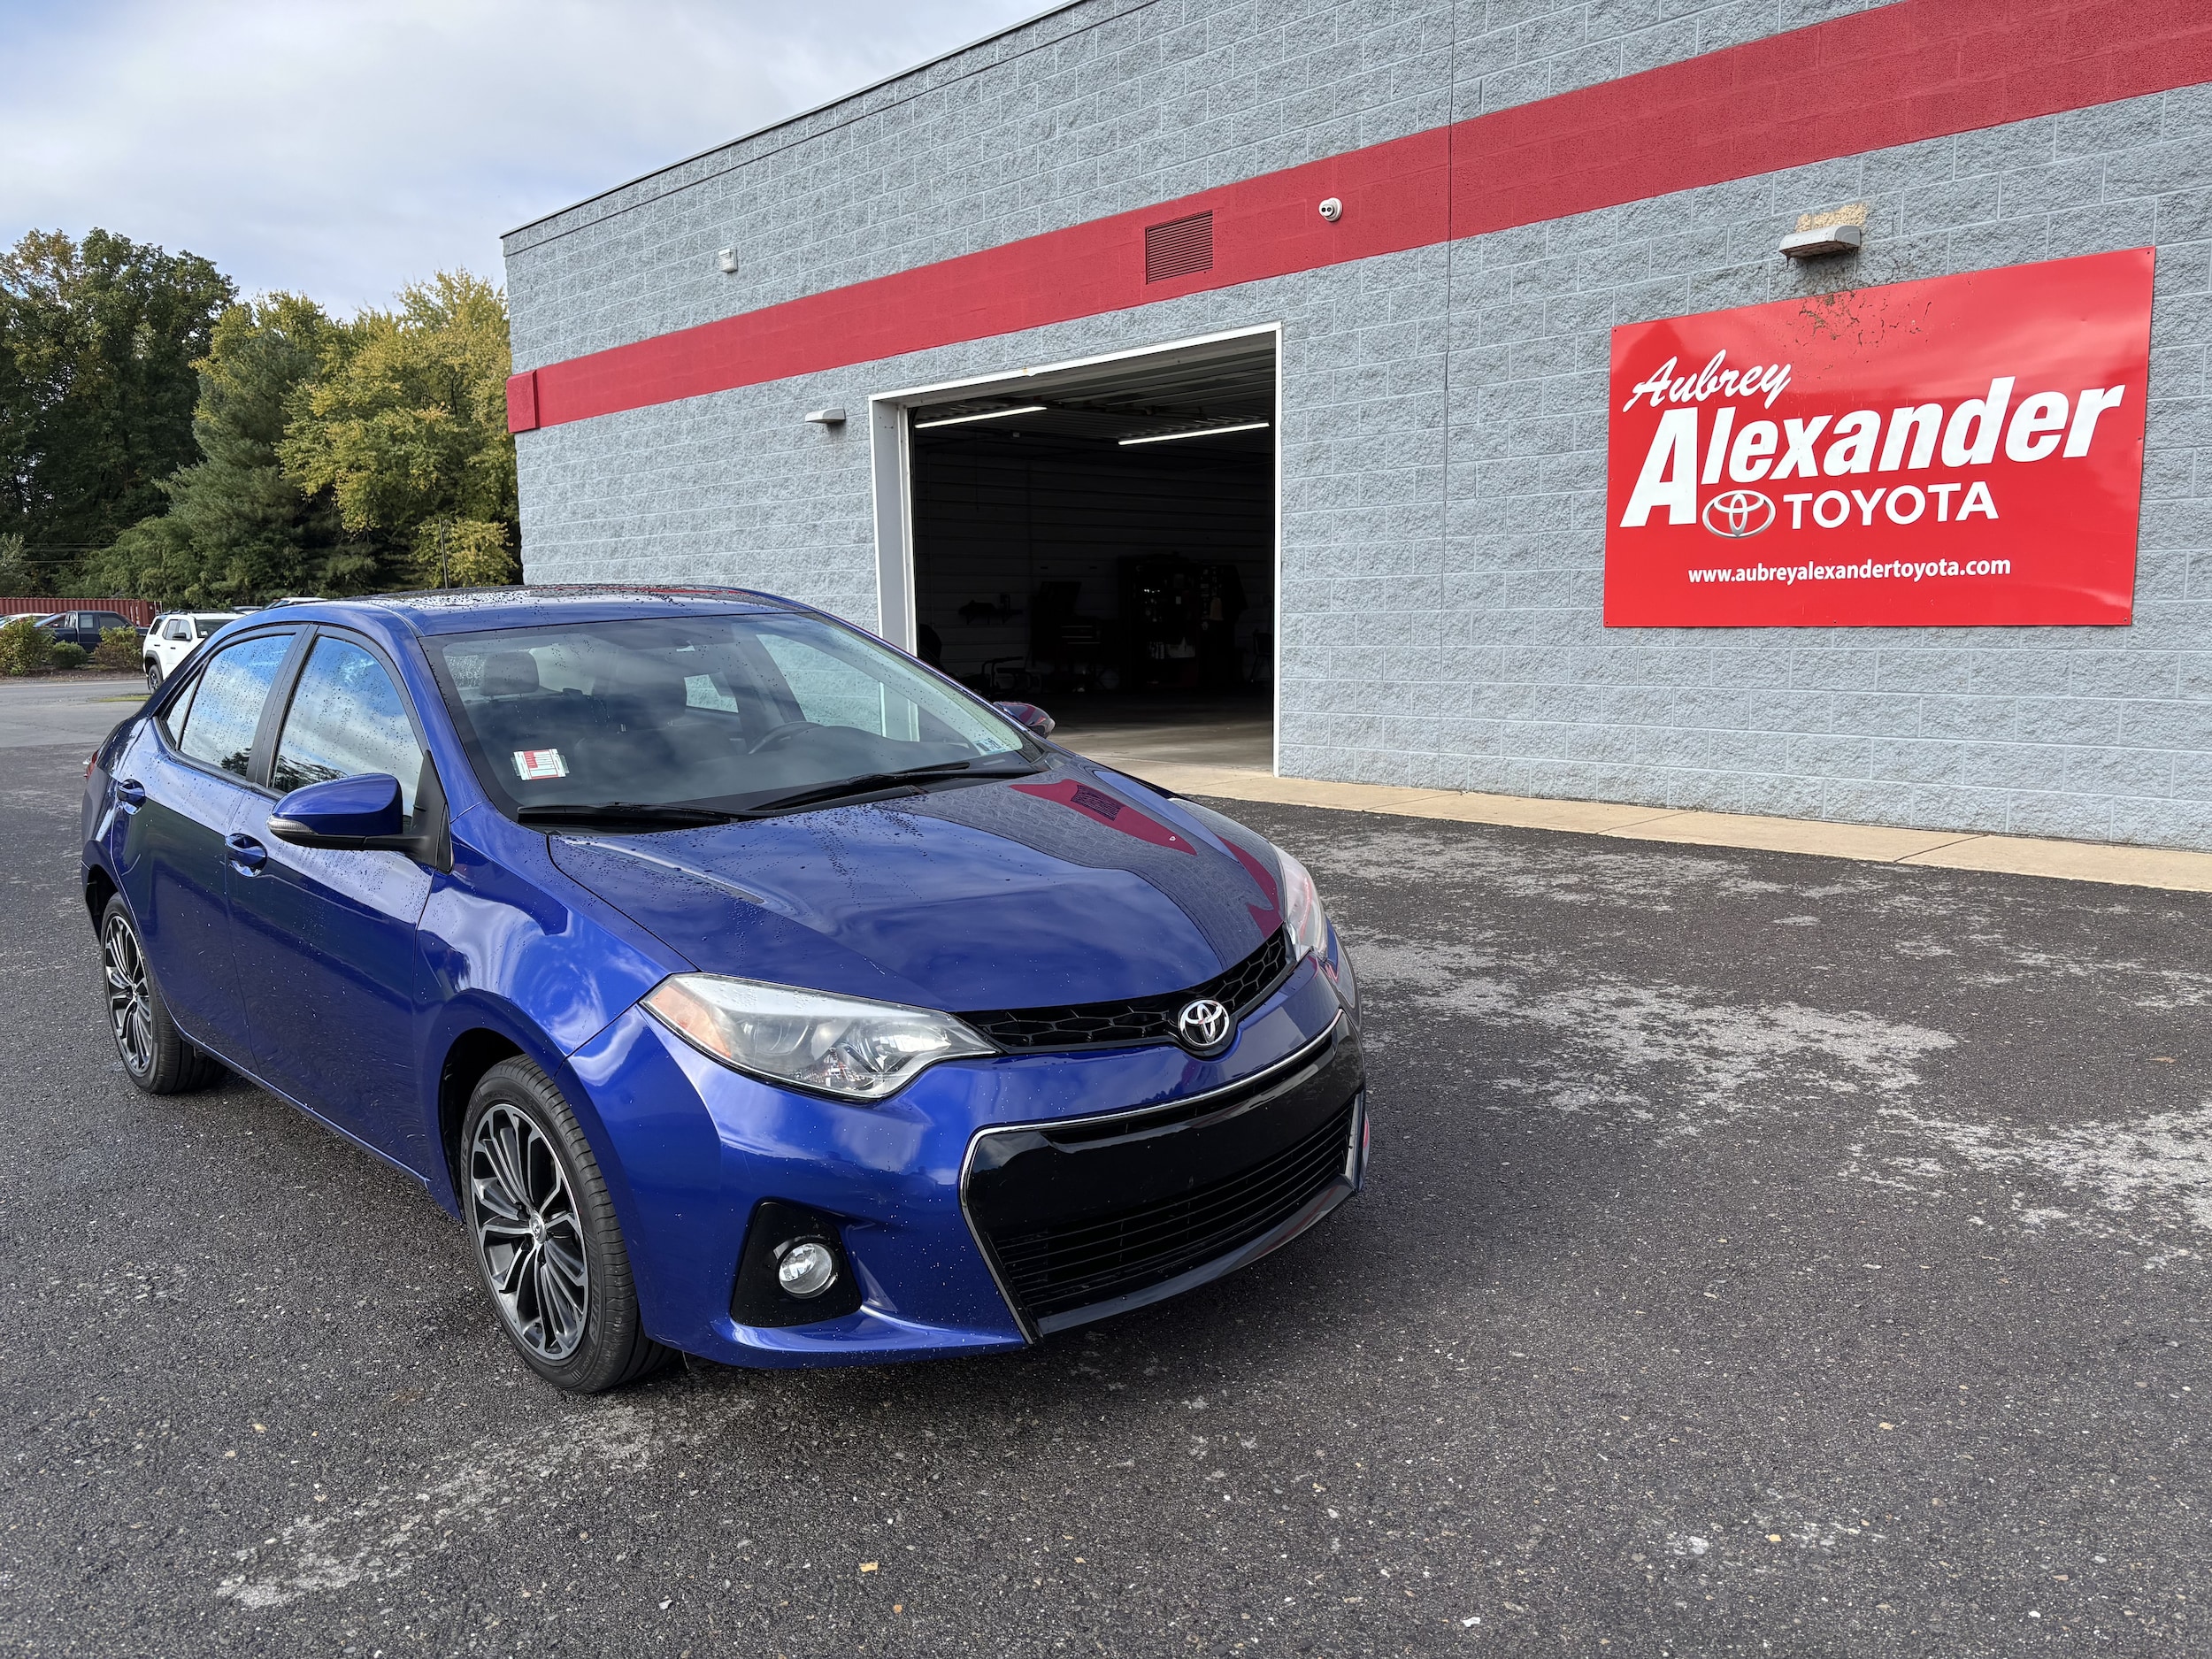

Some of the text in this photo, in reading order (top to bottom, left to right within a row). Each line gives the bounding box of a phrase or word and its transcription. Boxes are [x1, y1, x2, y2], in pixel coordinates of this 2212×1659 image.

[1622, 349, 1792, 412] Aubrey
[1619, 375, 2126, 528] Alexander
[1783, 480, 2000, 530] TOYOTA
[1687, 558, 2011, 586] www.aubreyalexandertoyota.com
